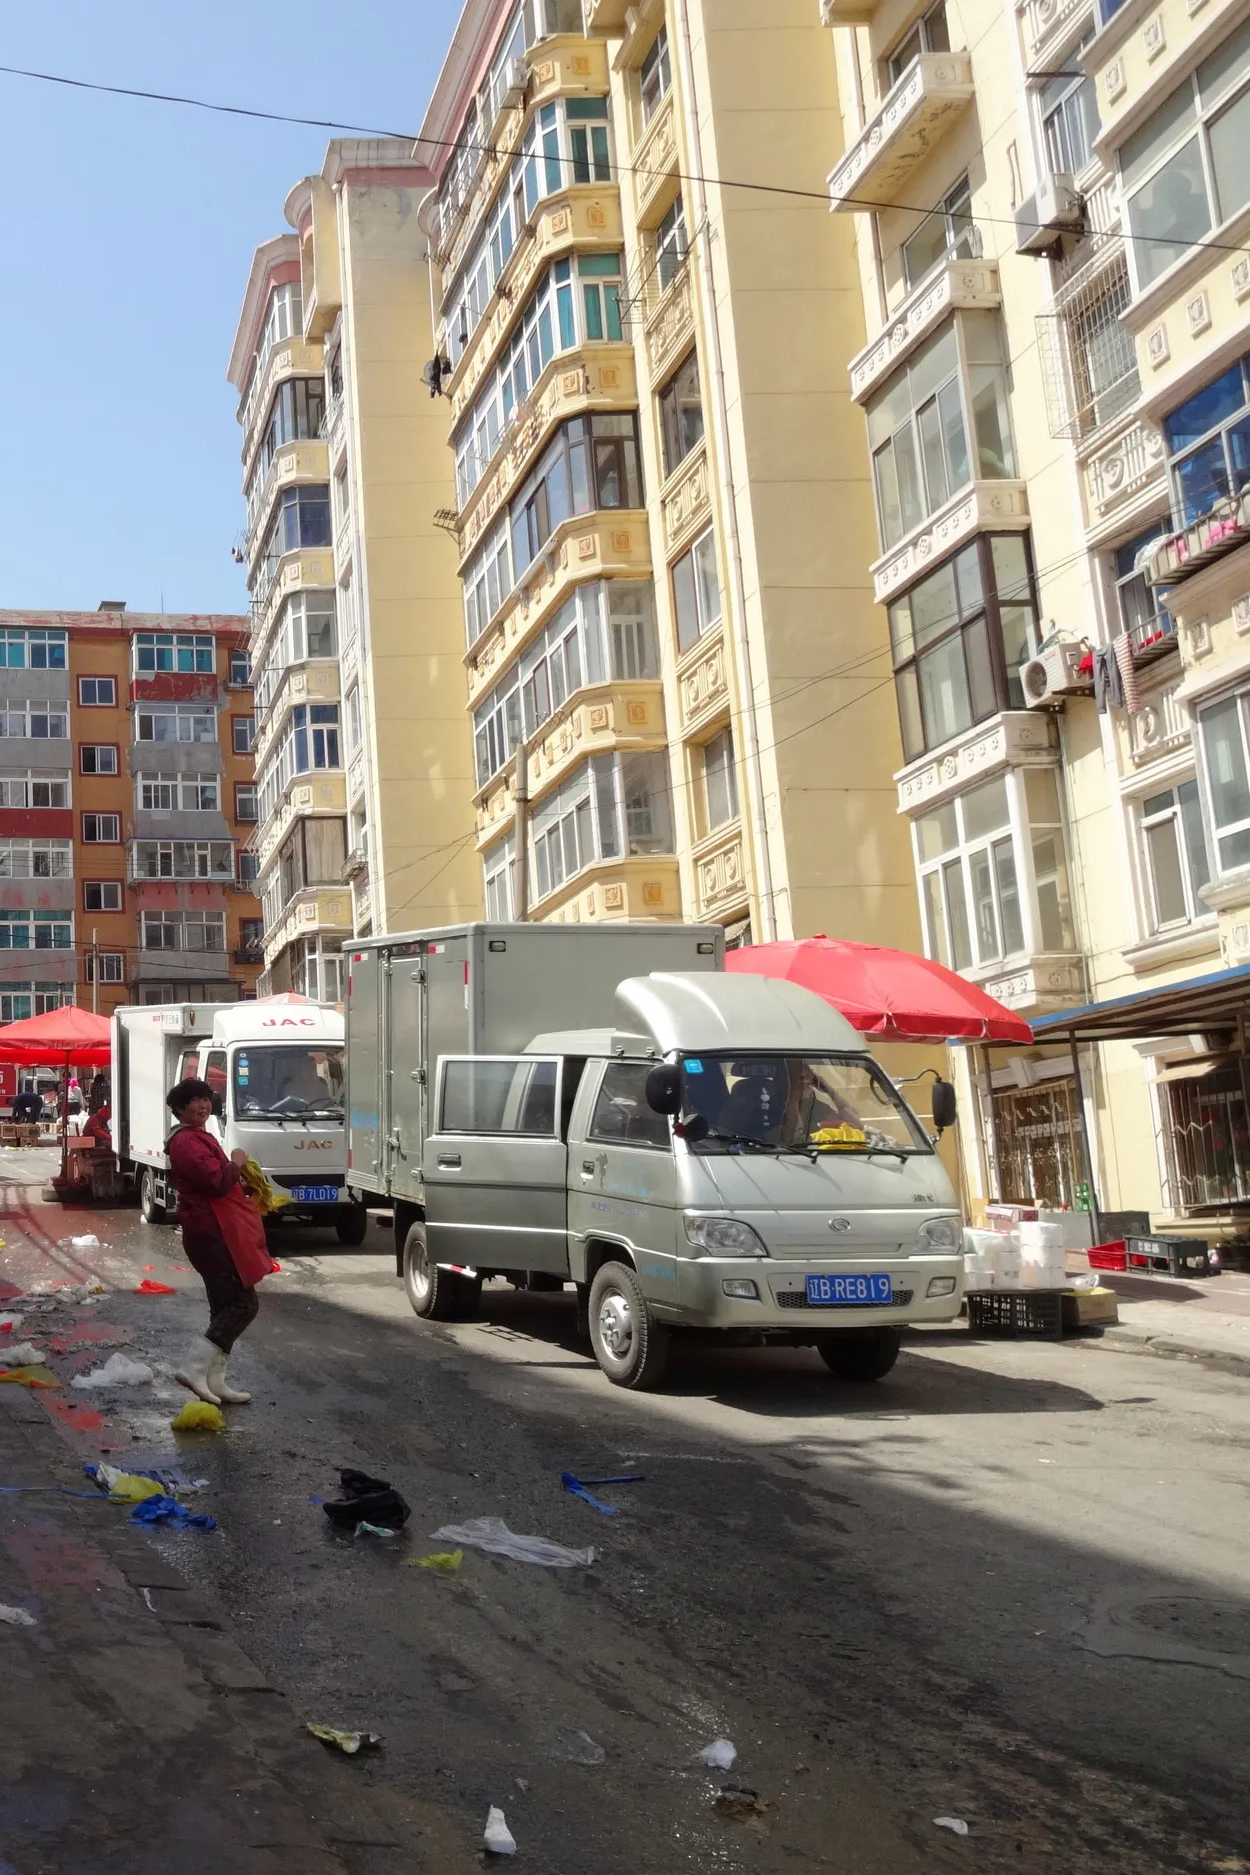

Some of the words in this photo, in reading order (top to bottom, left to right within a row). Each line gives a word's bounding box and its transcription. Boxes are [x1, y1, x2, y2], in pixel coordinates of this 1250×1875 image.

[262, 1018, 316, 1027] JAC
[294, 1139, 333, 1150] JAC
[810, 1278, 890, 1299] 辽B·RE819
